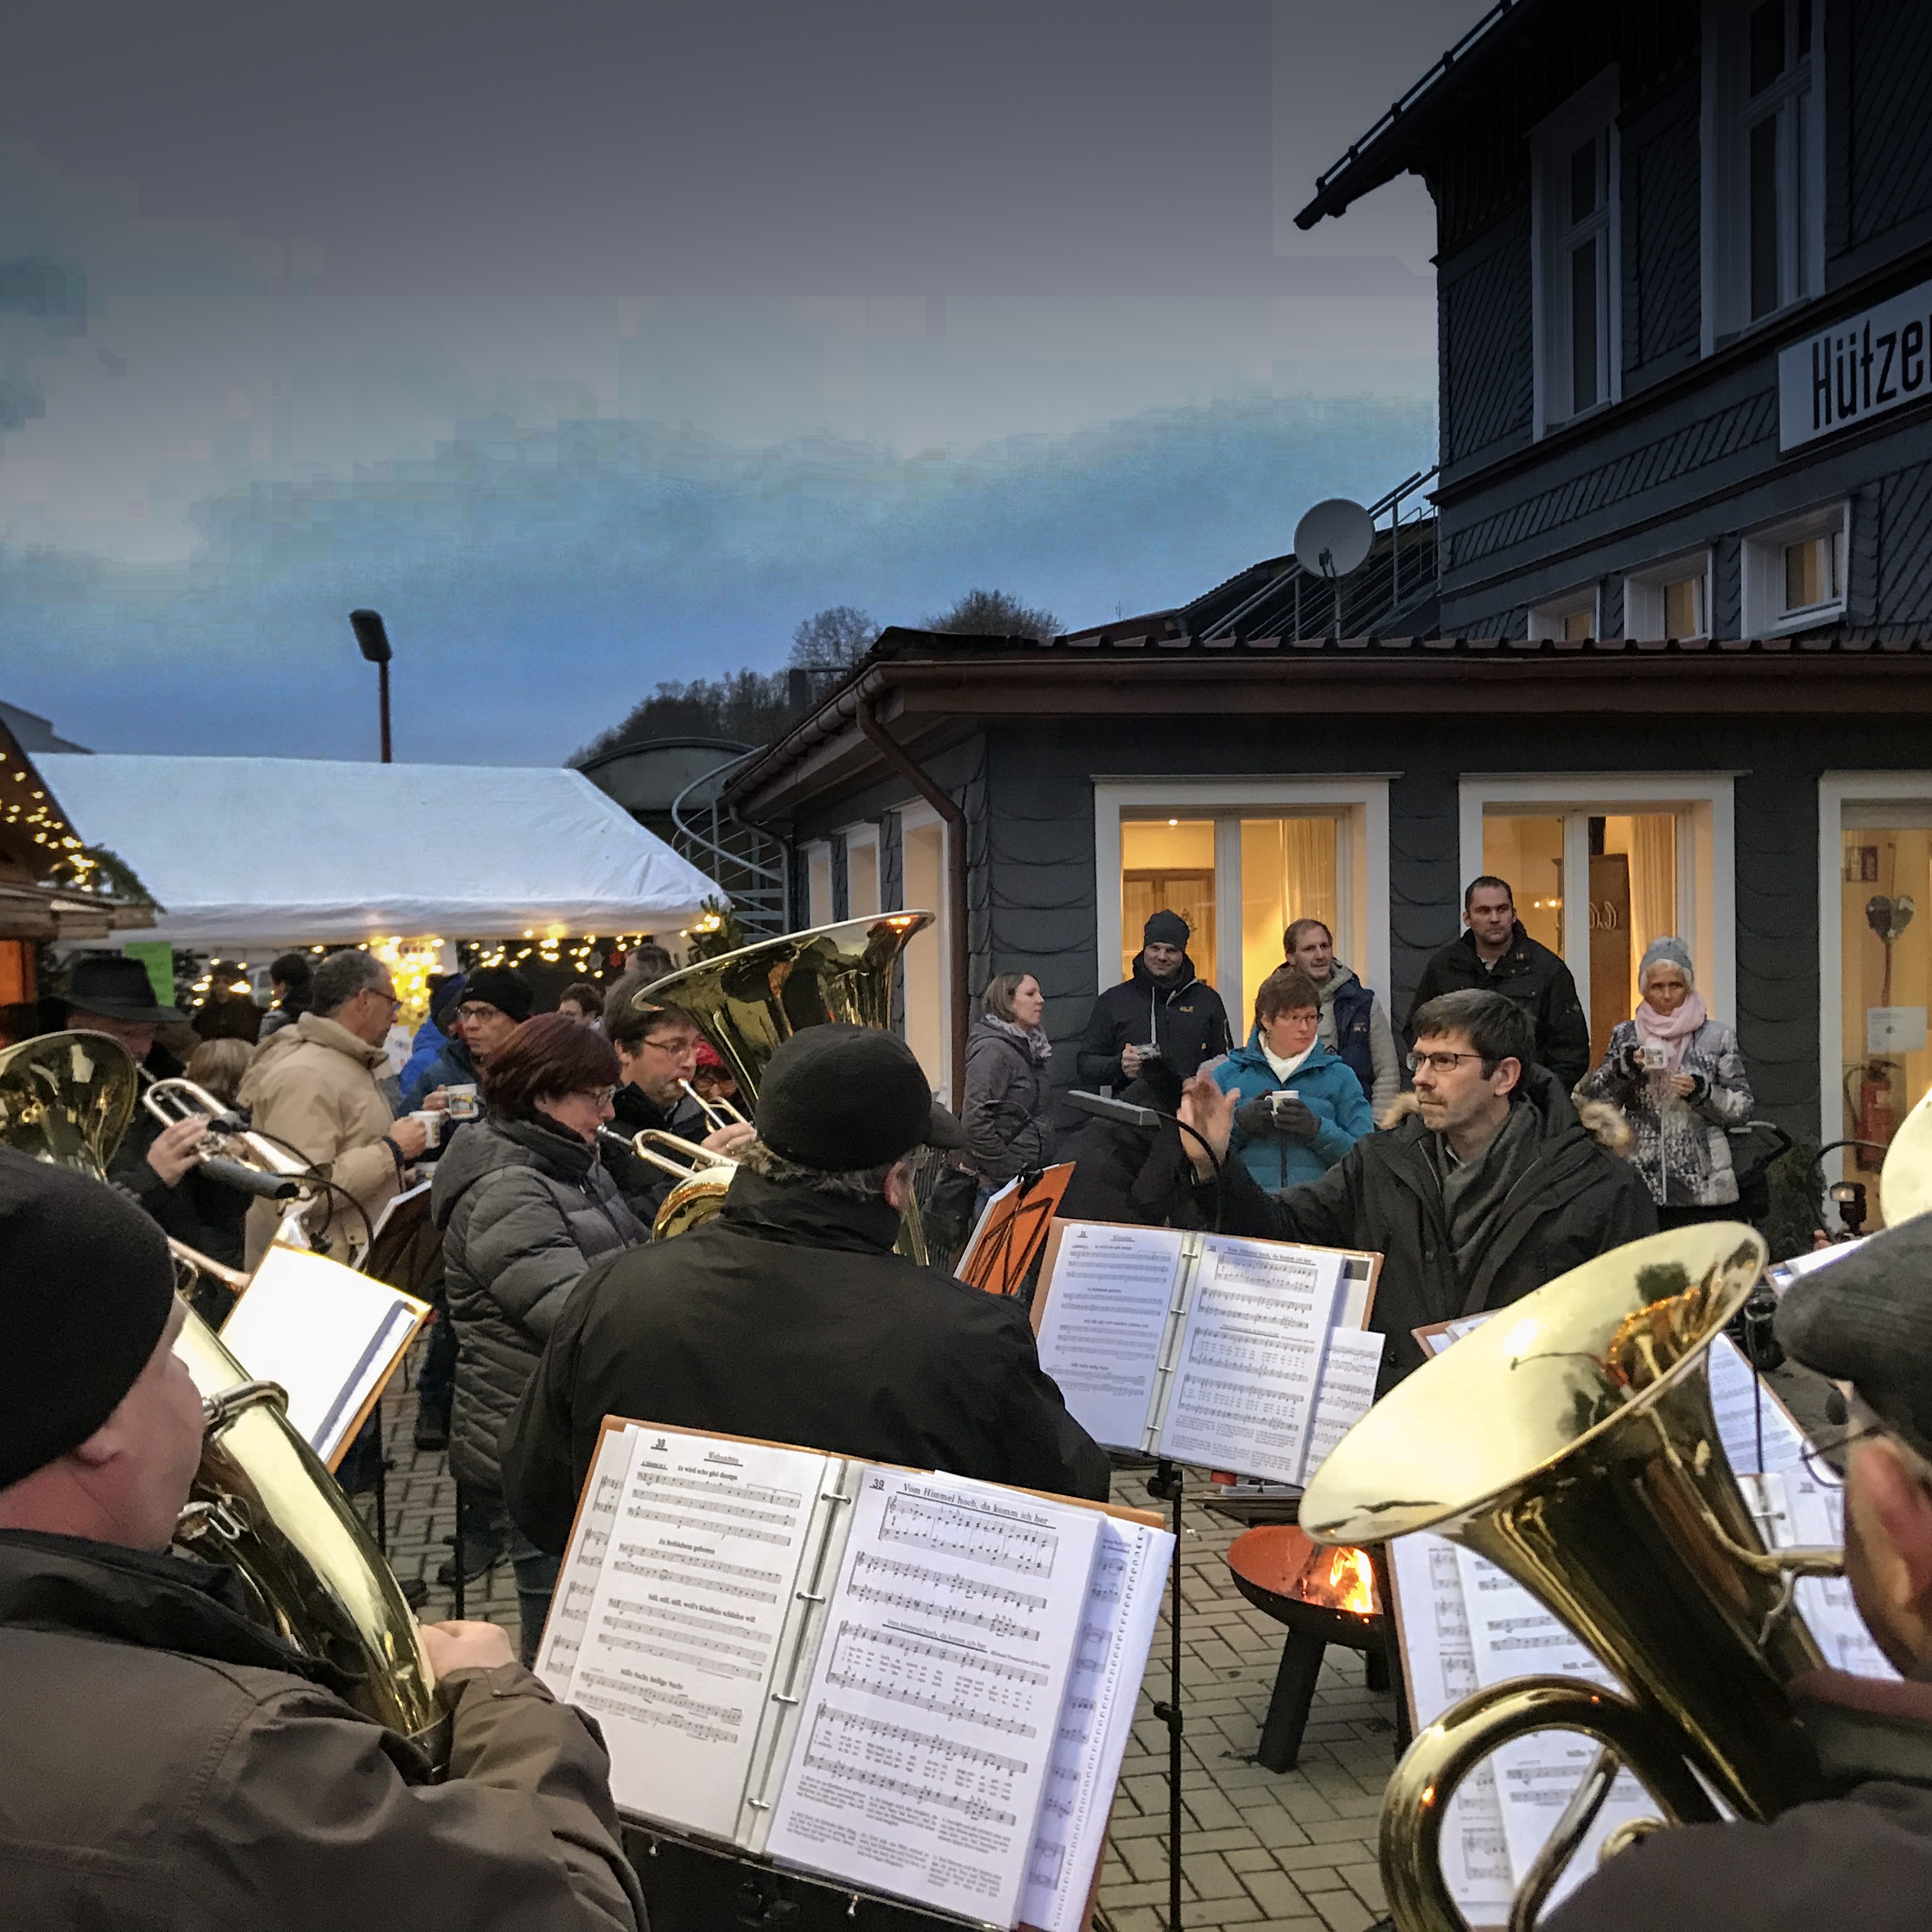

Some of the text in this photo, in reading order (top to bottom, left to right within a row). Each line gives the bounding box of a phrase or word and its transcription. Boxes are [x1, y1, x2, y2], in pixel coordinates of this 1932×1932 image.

[1813, 313, 1932, 430] Hütze
[873, 1478, 885, 1490] 39
[903, 1483, 921, 1494] Vom
[923, 1485, 955, 1503] Himmel
[981, 1501, 991, 1512] da
[993, 1504, 1018, 1518] komm
[1021, 1511, 1032, 1521] ich
[1034, 1514, 1048, 1525] her
